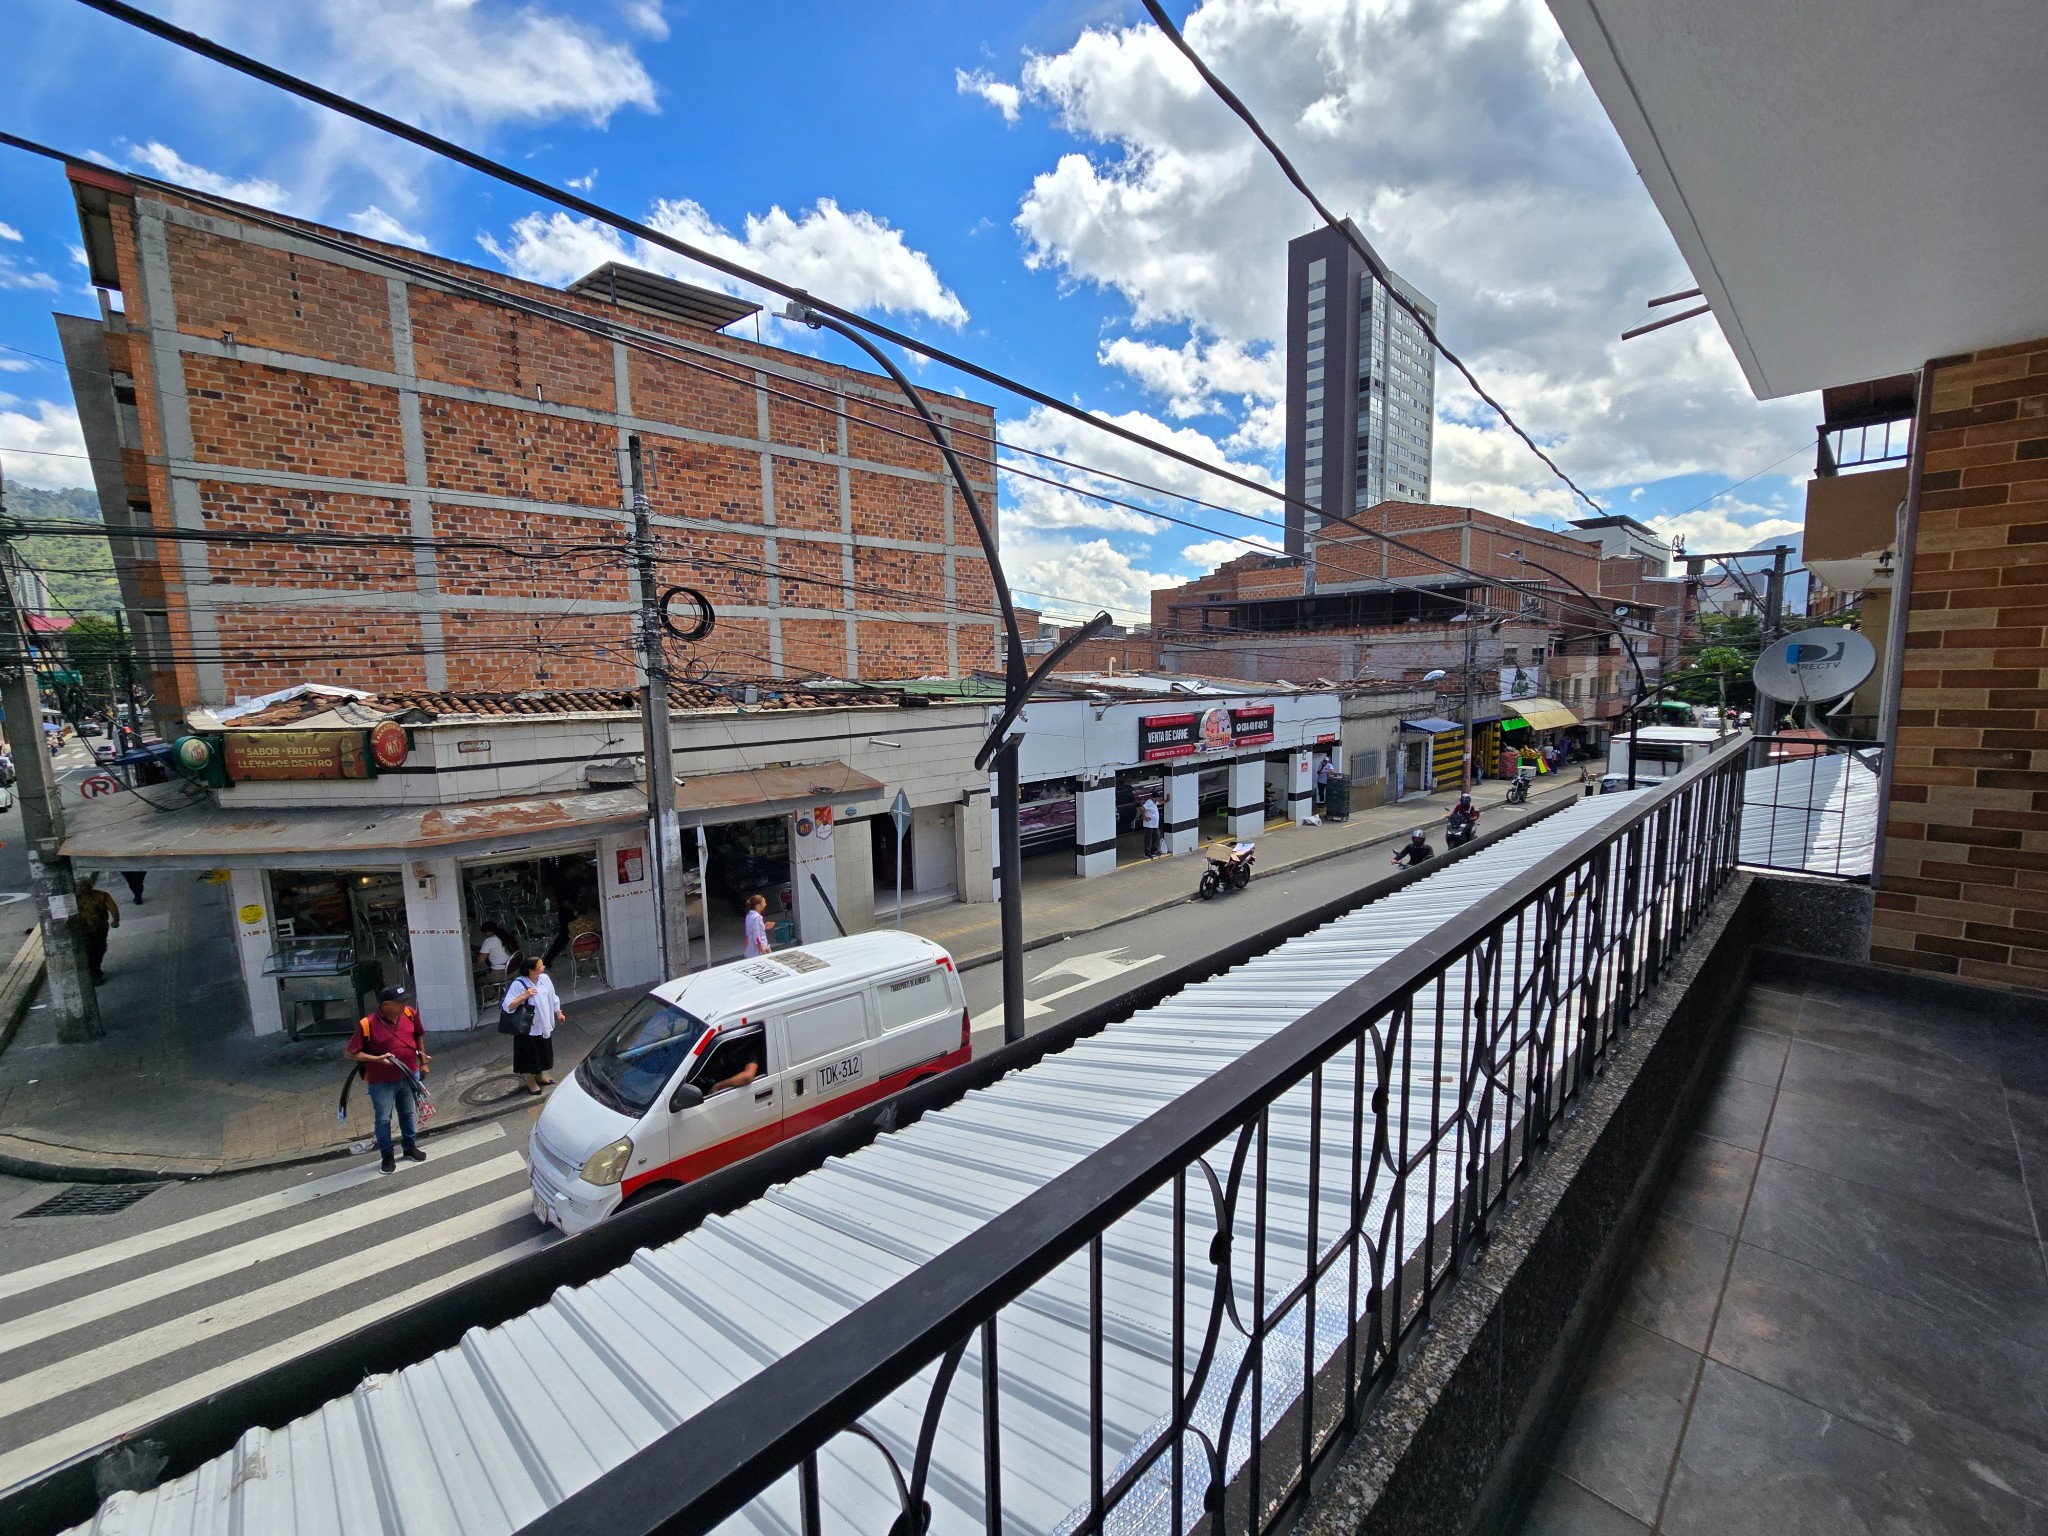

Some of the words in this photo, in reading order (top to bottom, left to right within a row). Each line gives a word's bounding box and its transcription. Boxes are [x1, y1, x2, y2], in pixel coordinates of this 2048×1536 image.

[1147, 730, 1165, 743] VENTA
[1165, 729, 1172, 741] DE
[1172, 728, 1189, 741] CARNE
[246, 747, 280, 756] SABOR
[286, 746, 319, 756] FRUTA
[237, 759, 290, 769] LLEVAMOS
[291, 758, 333, 768] DENTRO
[819, 1056, 860, 1087] TDK-312
